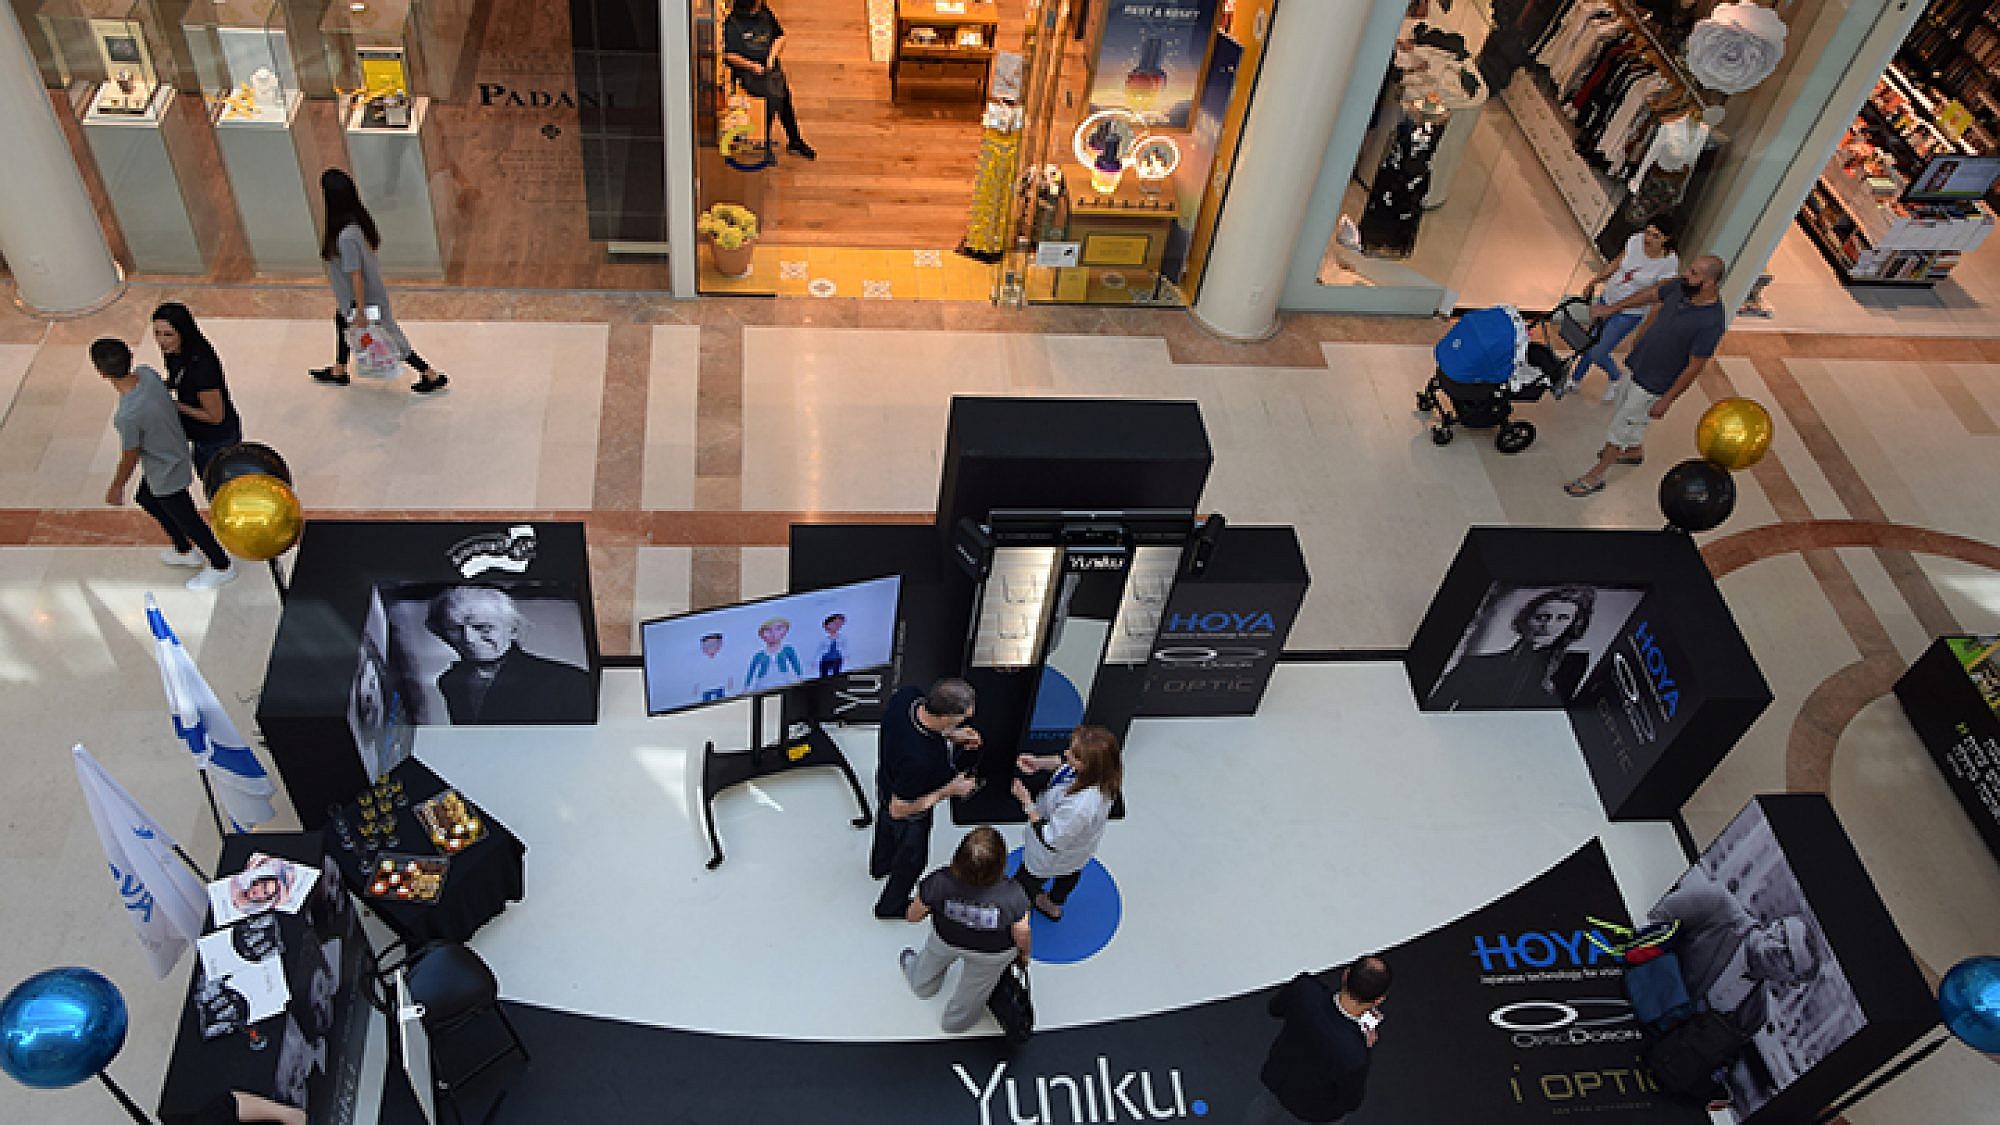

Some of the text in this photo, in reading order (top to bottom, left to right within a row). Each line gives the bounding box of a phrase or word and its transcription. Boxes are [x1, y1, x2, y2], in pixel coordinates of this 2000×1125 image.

[1068, 554, 1127, 570] Yuniku
[1169, 611, 1276, 632] HOYA
[1635, 621, 1680, 718] HOYA
[1471, 929, 1626, 970] HOYA
